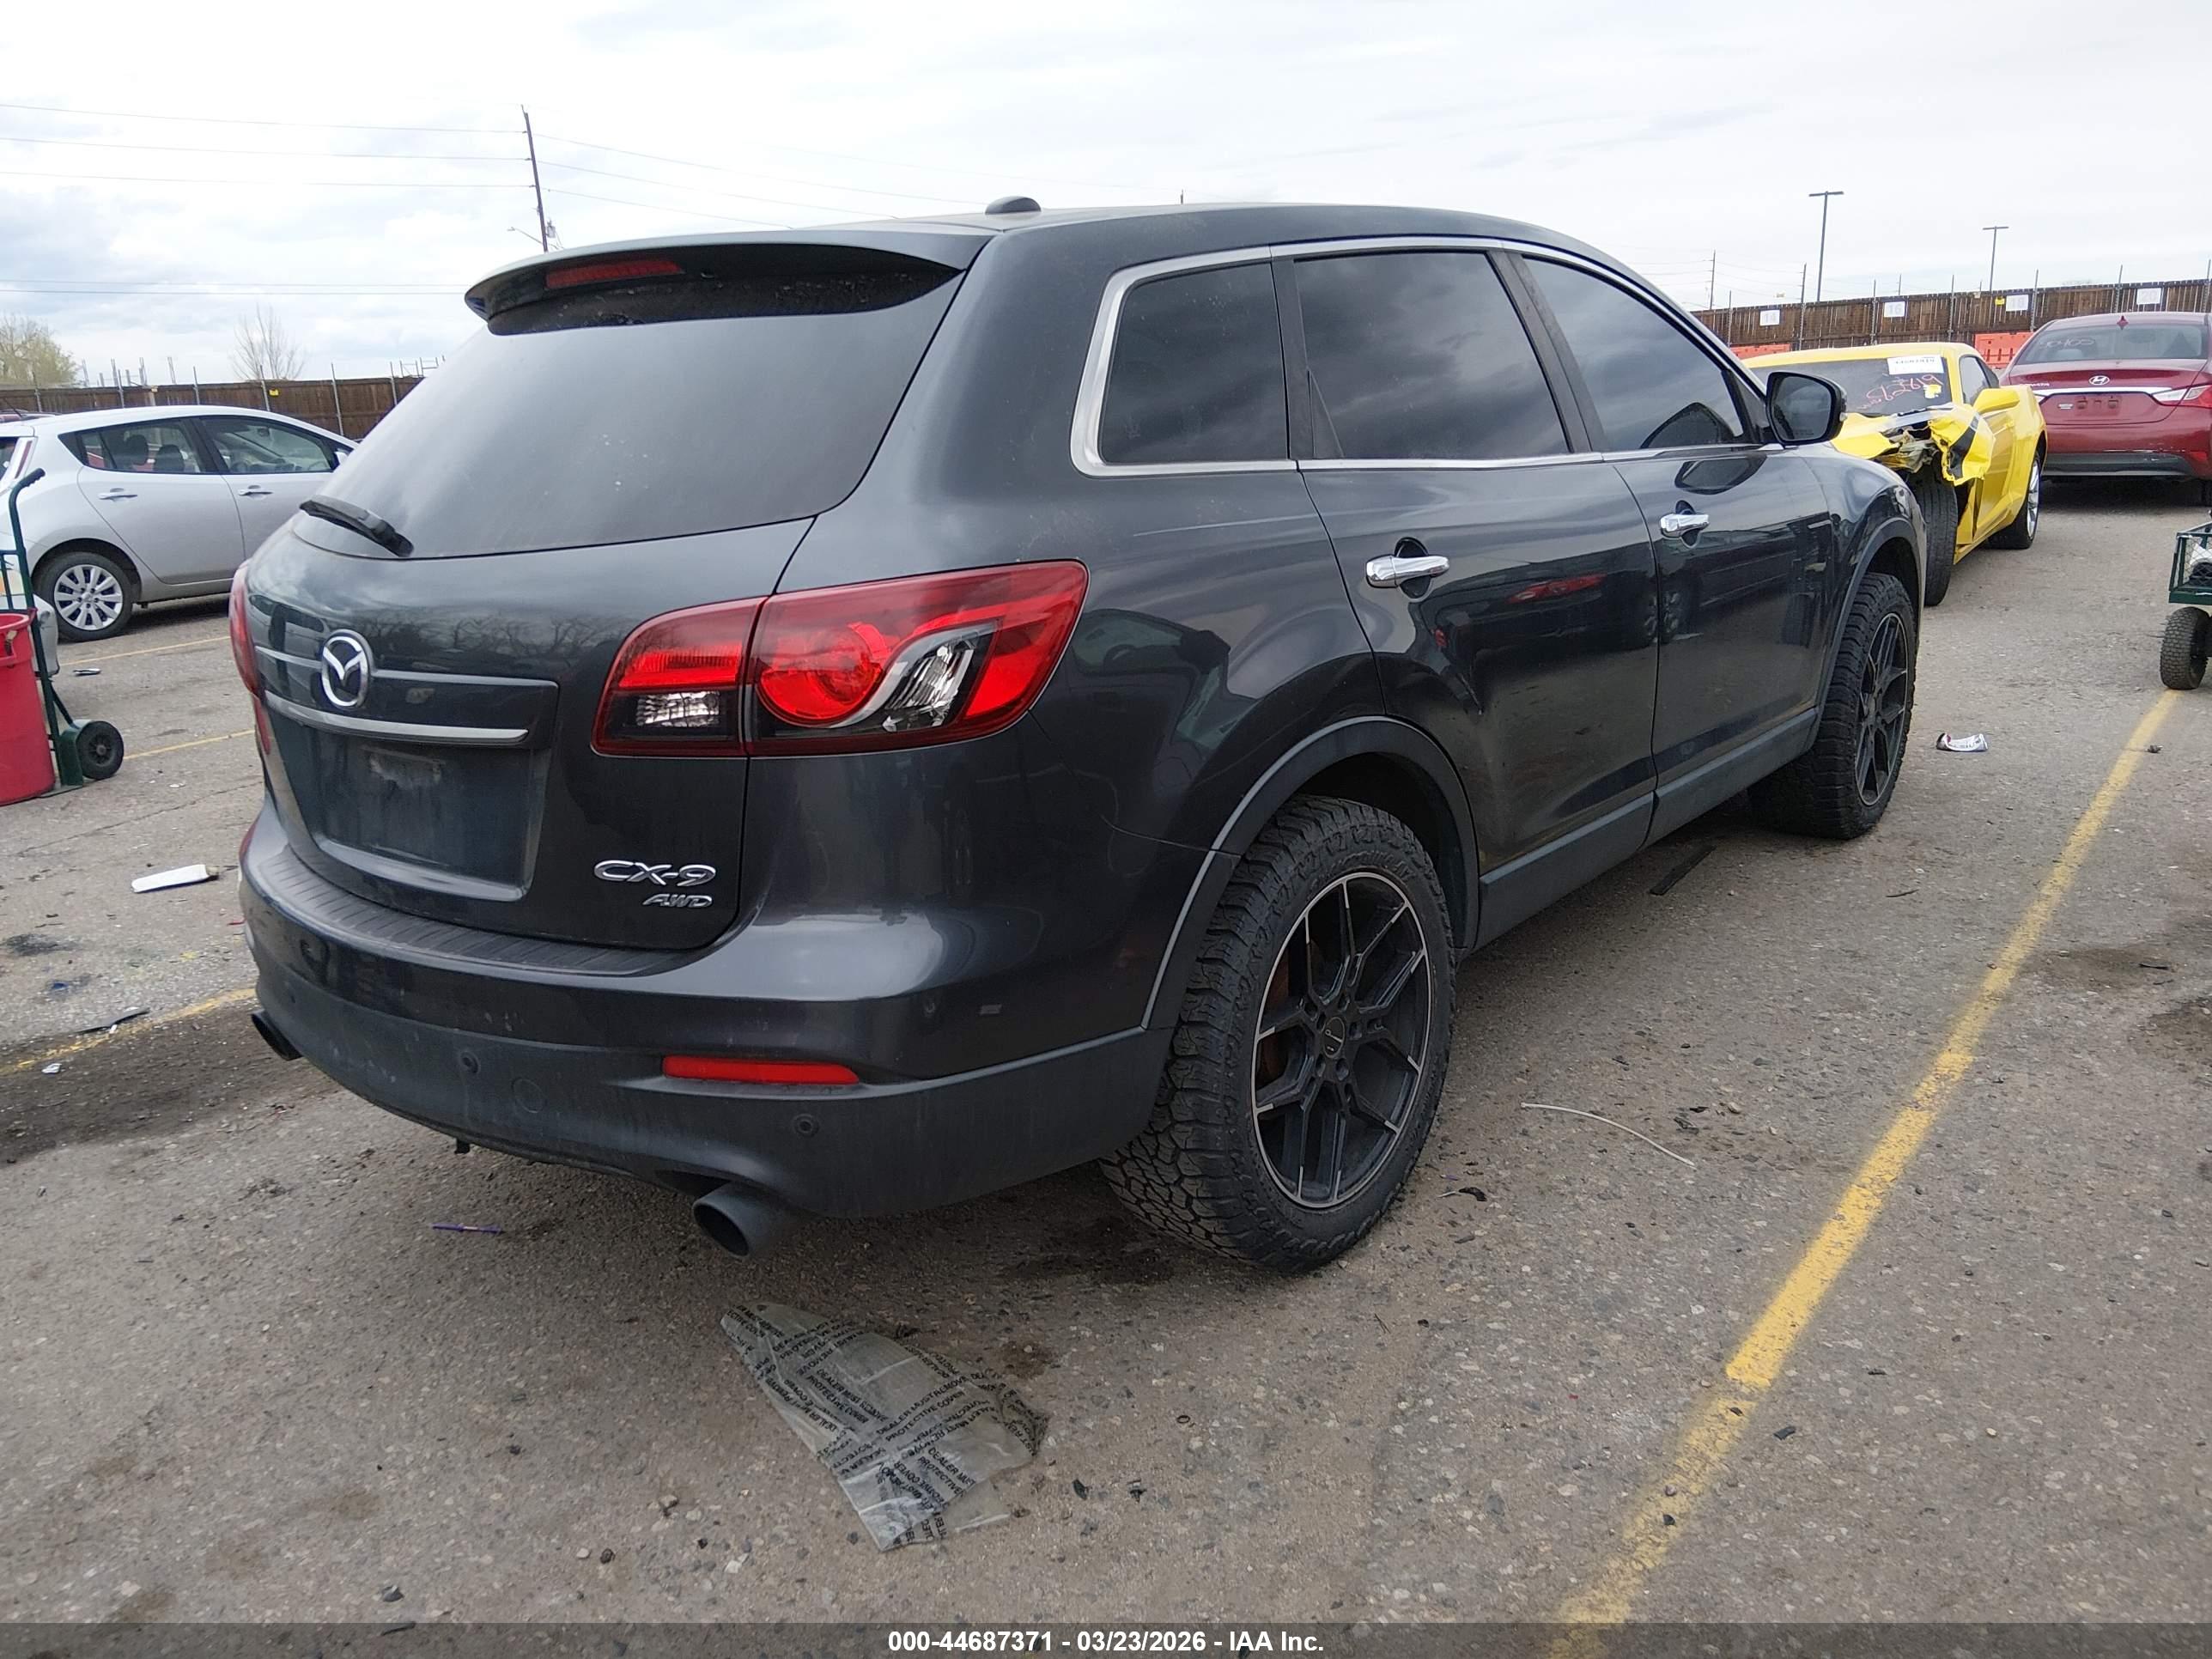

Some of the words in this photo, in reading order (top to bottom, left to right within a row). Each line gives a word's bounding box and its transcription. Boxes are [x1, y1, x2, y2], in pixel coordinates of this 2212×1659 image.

[594, 860, 716, 886] CX-9
[642, 893, 713, 908] AWD
[927, 1446, 959, 1475] DEALER
